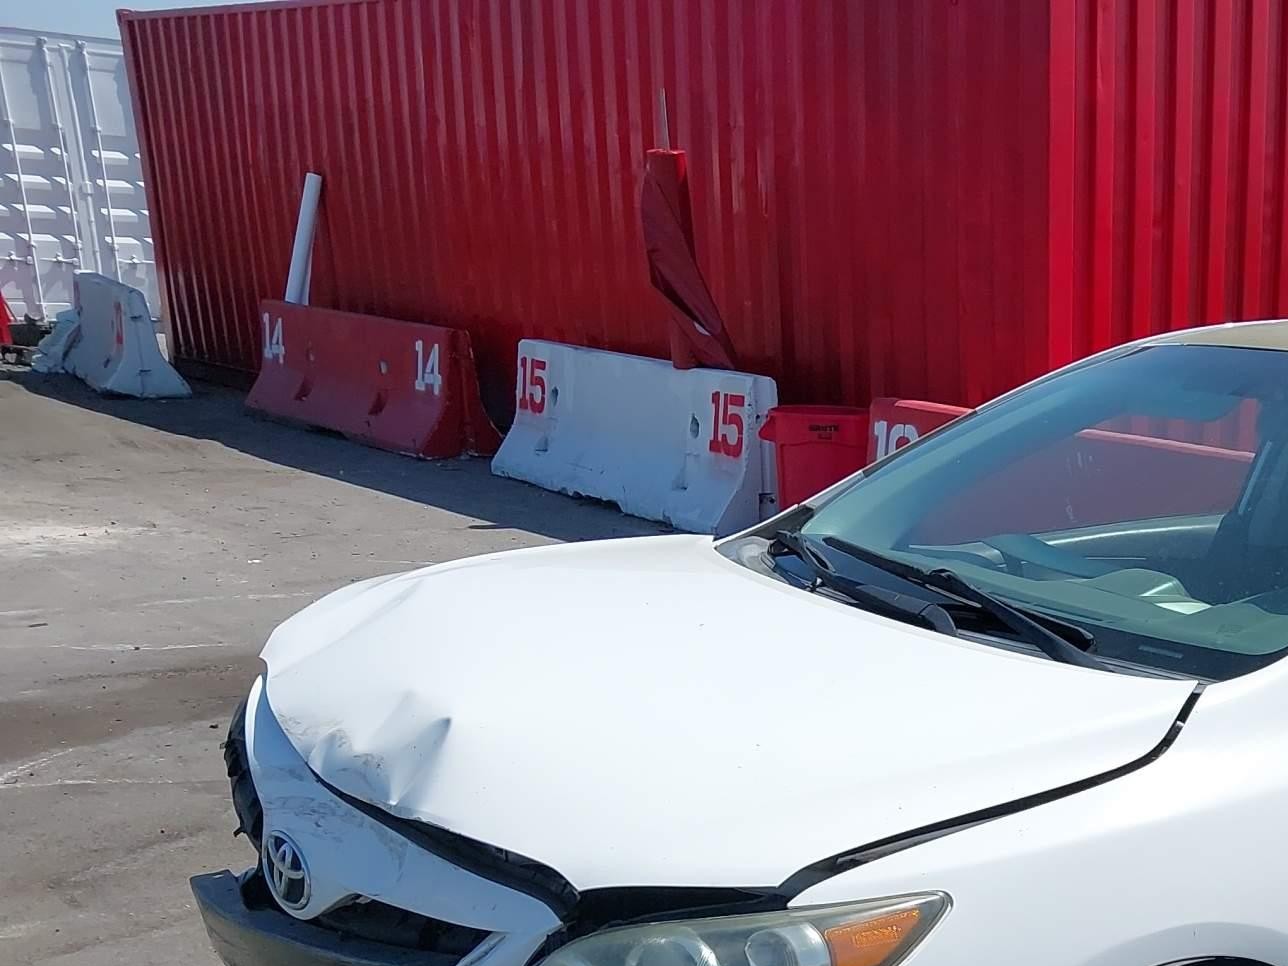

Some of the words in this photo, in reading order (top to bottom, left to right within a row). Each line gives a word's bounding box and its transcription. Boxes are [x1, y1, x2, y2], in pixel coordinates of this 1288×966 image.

[262, 312, 285, 364] 14
[415, 340, 442, 395] 14
[518, 356, 547, 414] 15
[708, 391, 746, 459] 15
